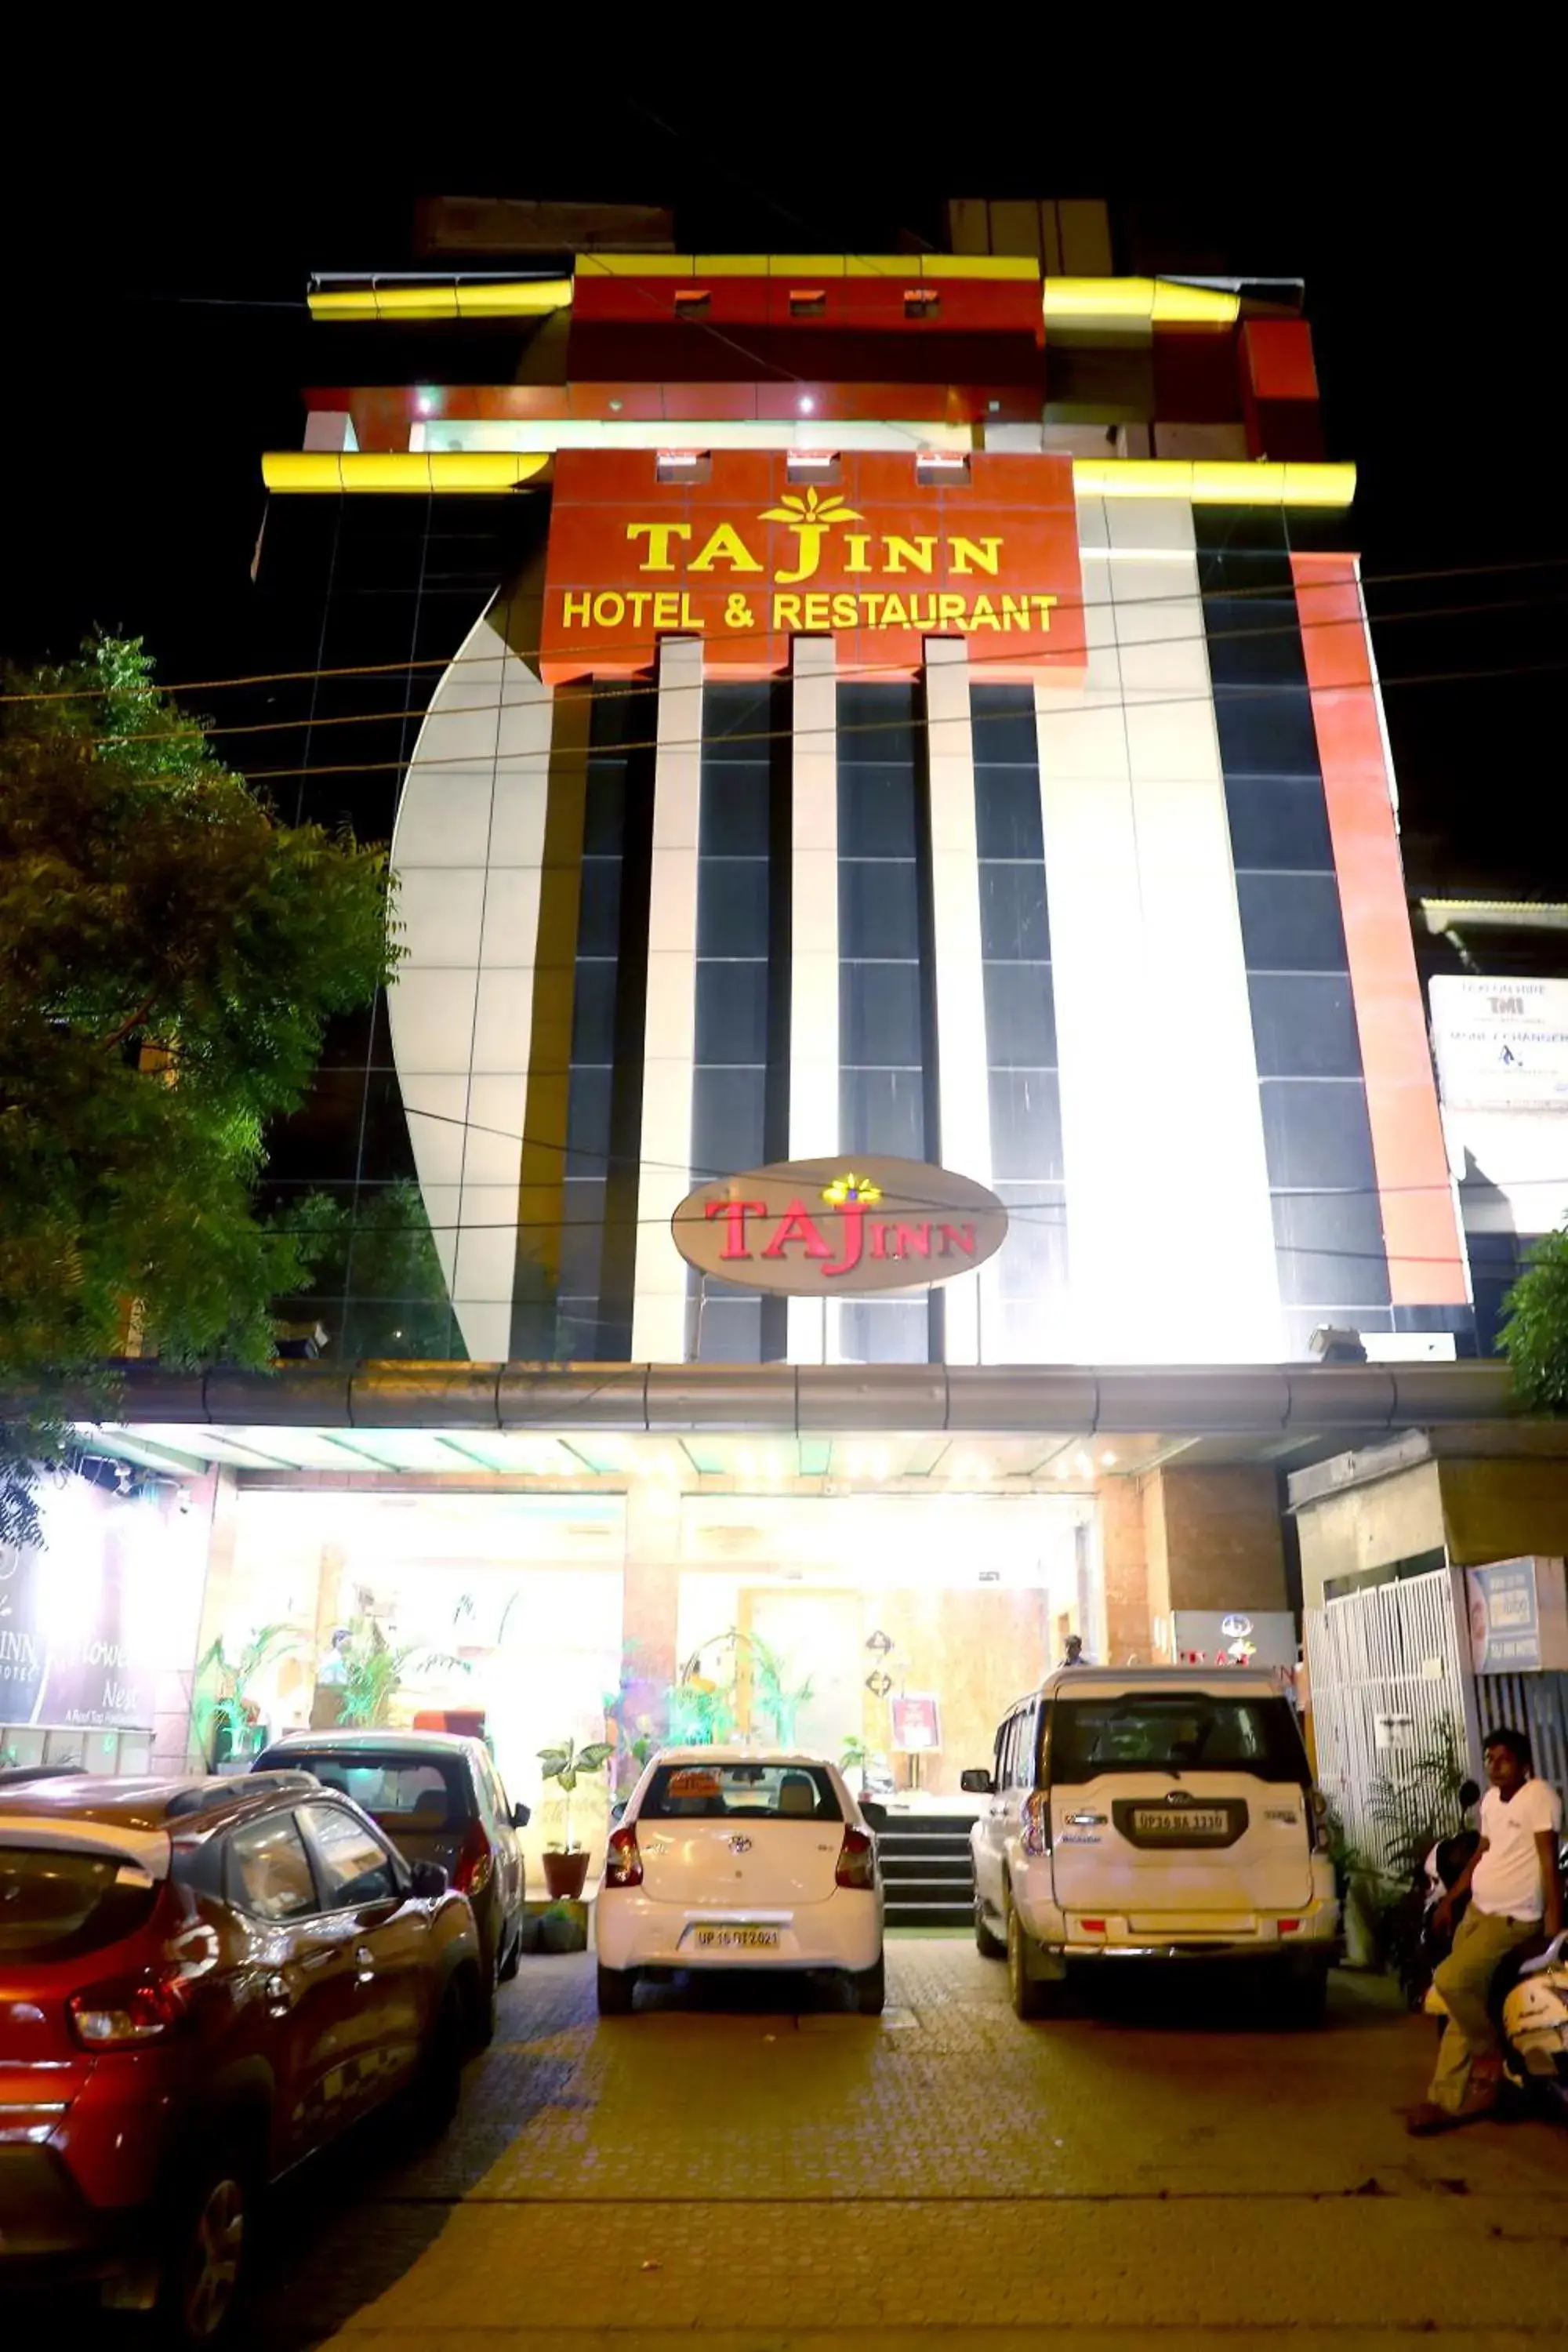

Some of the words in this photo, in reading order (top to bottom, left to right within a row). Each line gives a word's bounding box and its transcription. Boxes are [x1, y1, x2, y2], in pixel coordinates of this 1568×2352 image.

[563, 591, 704, 628] HOTEL
[724, 593, 754, 628] &
[773, 593, 1058, 632] RESTAURANT
